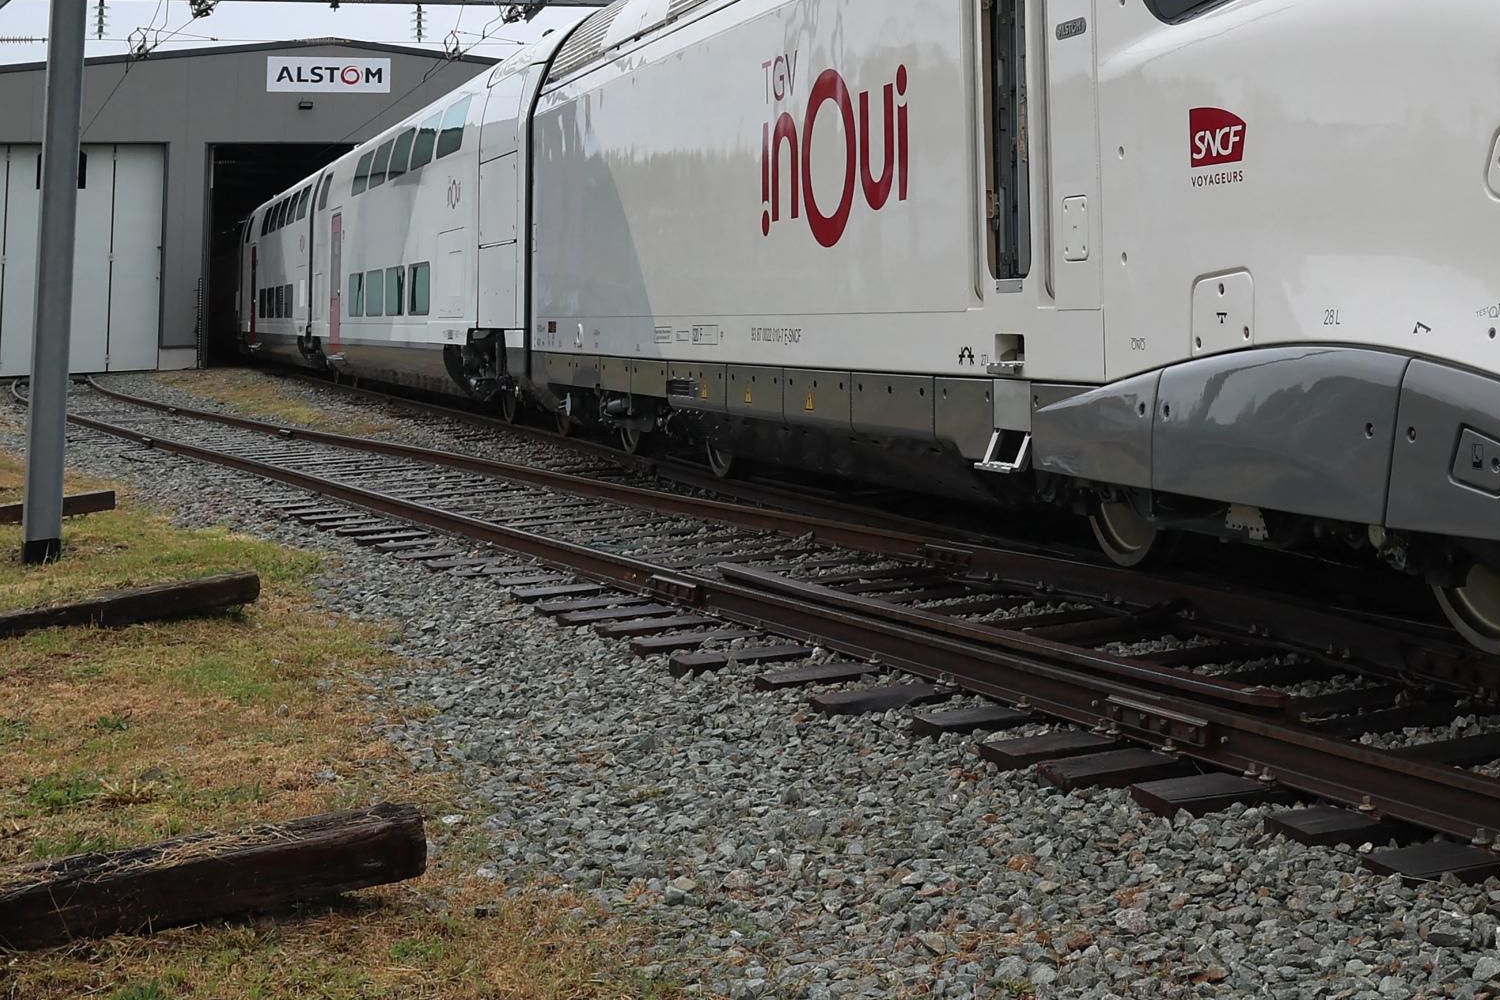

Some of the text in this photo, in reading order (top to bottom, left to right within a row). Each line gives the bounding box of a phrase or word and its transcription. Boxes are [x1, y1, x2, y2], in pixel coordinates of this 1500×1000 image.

[276, 65, 383, 85] ALSTOM
[762, 50, 798, 105] TGV
[1193, 125, 1242, 159] SNCF
[1191, 171, 1243, 187] VOYAGEURS
